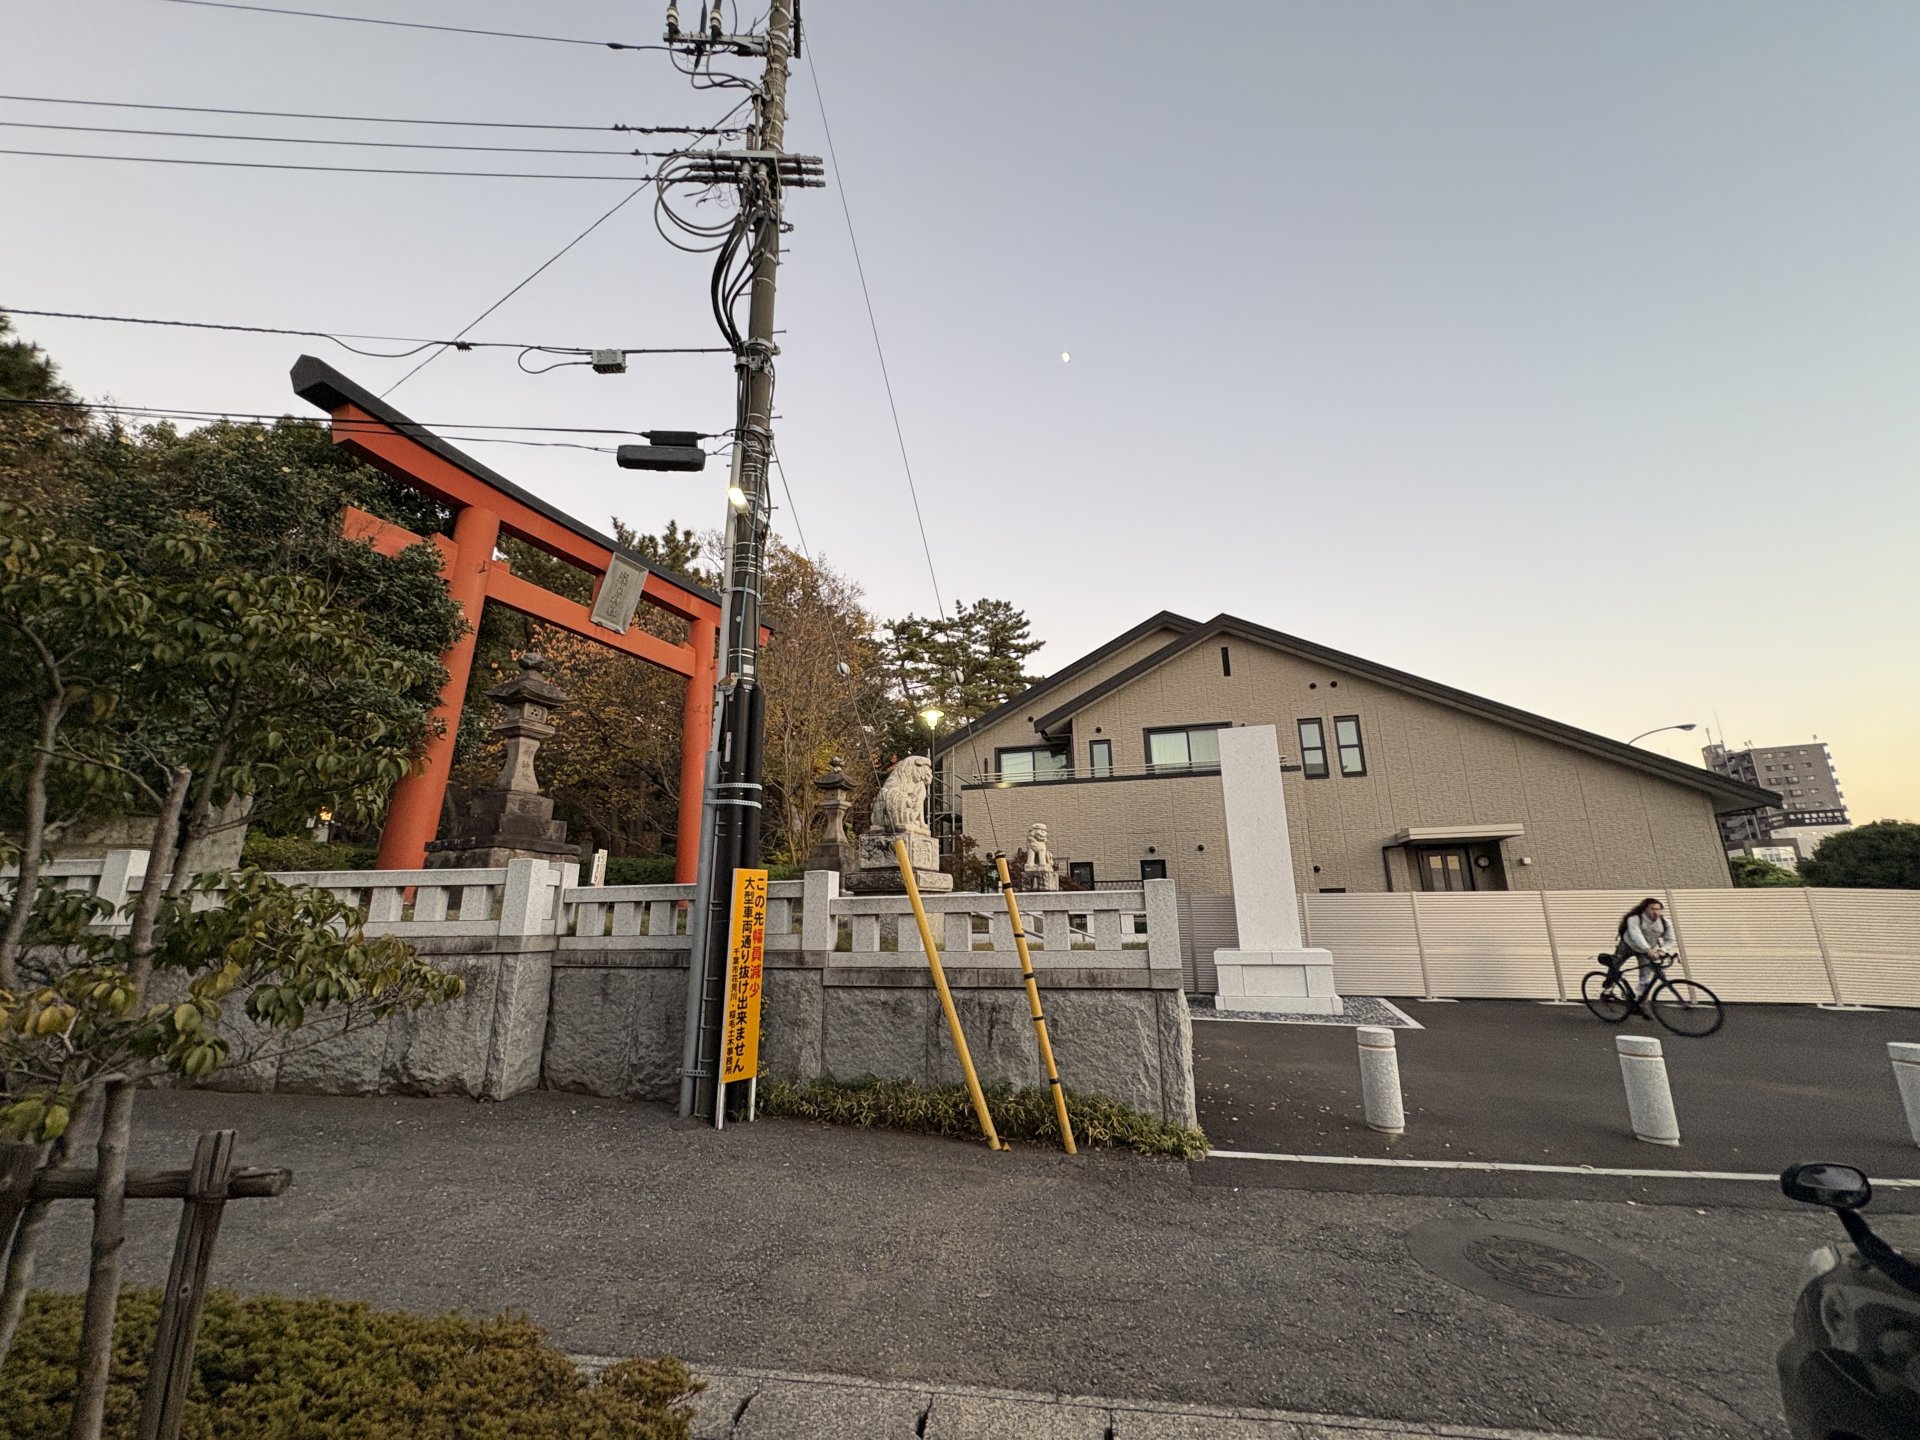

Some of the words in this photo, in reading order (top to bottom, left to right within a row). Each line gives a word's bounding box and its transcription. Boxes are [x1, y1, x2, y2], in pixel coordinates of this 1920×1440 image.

[733, 877, 755, 1073] 大型車両通り抜け出来ません
[749, 878, 765, 998] この先幅員減少
